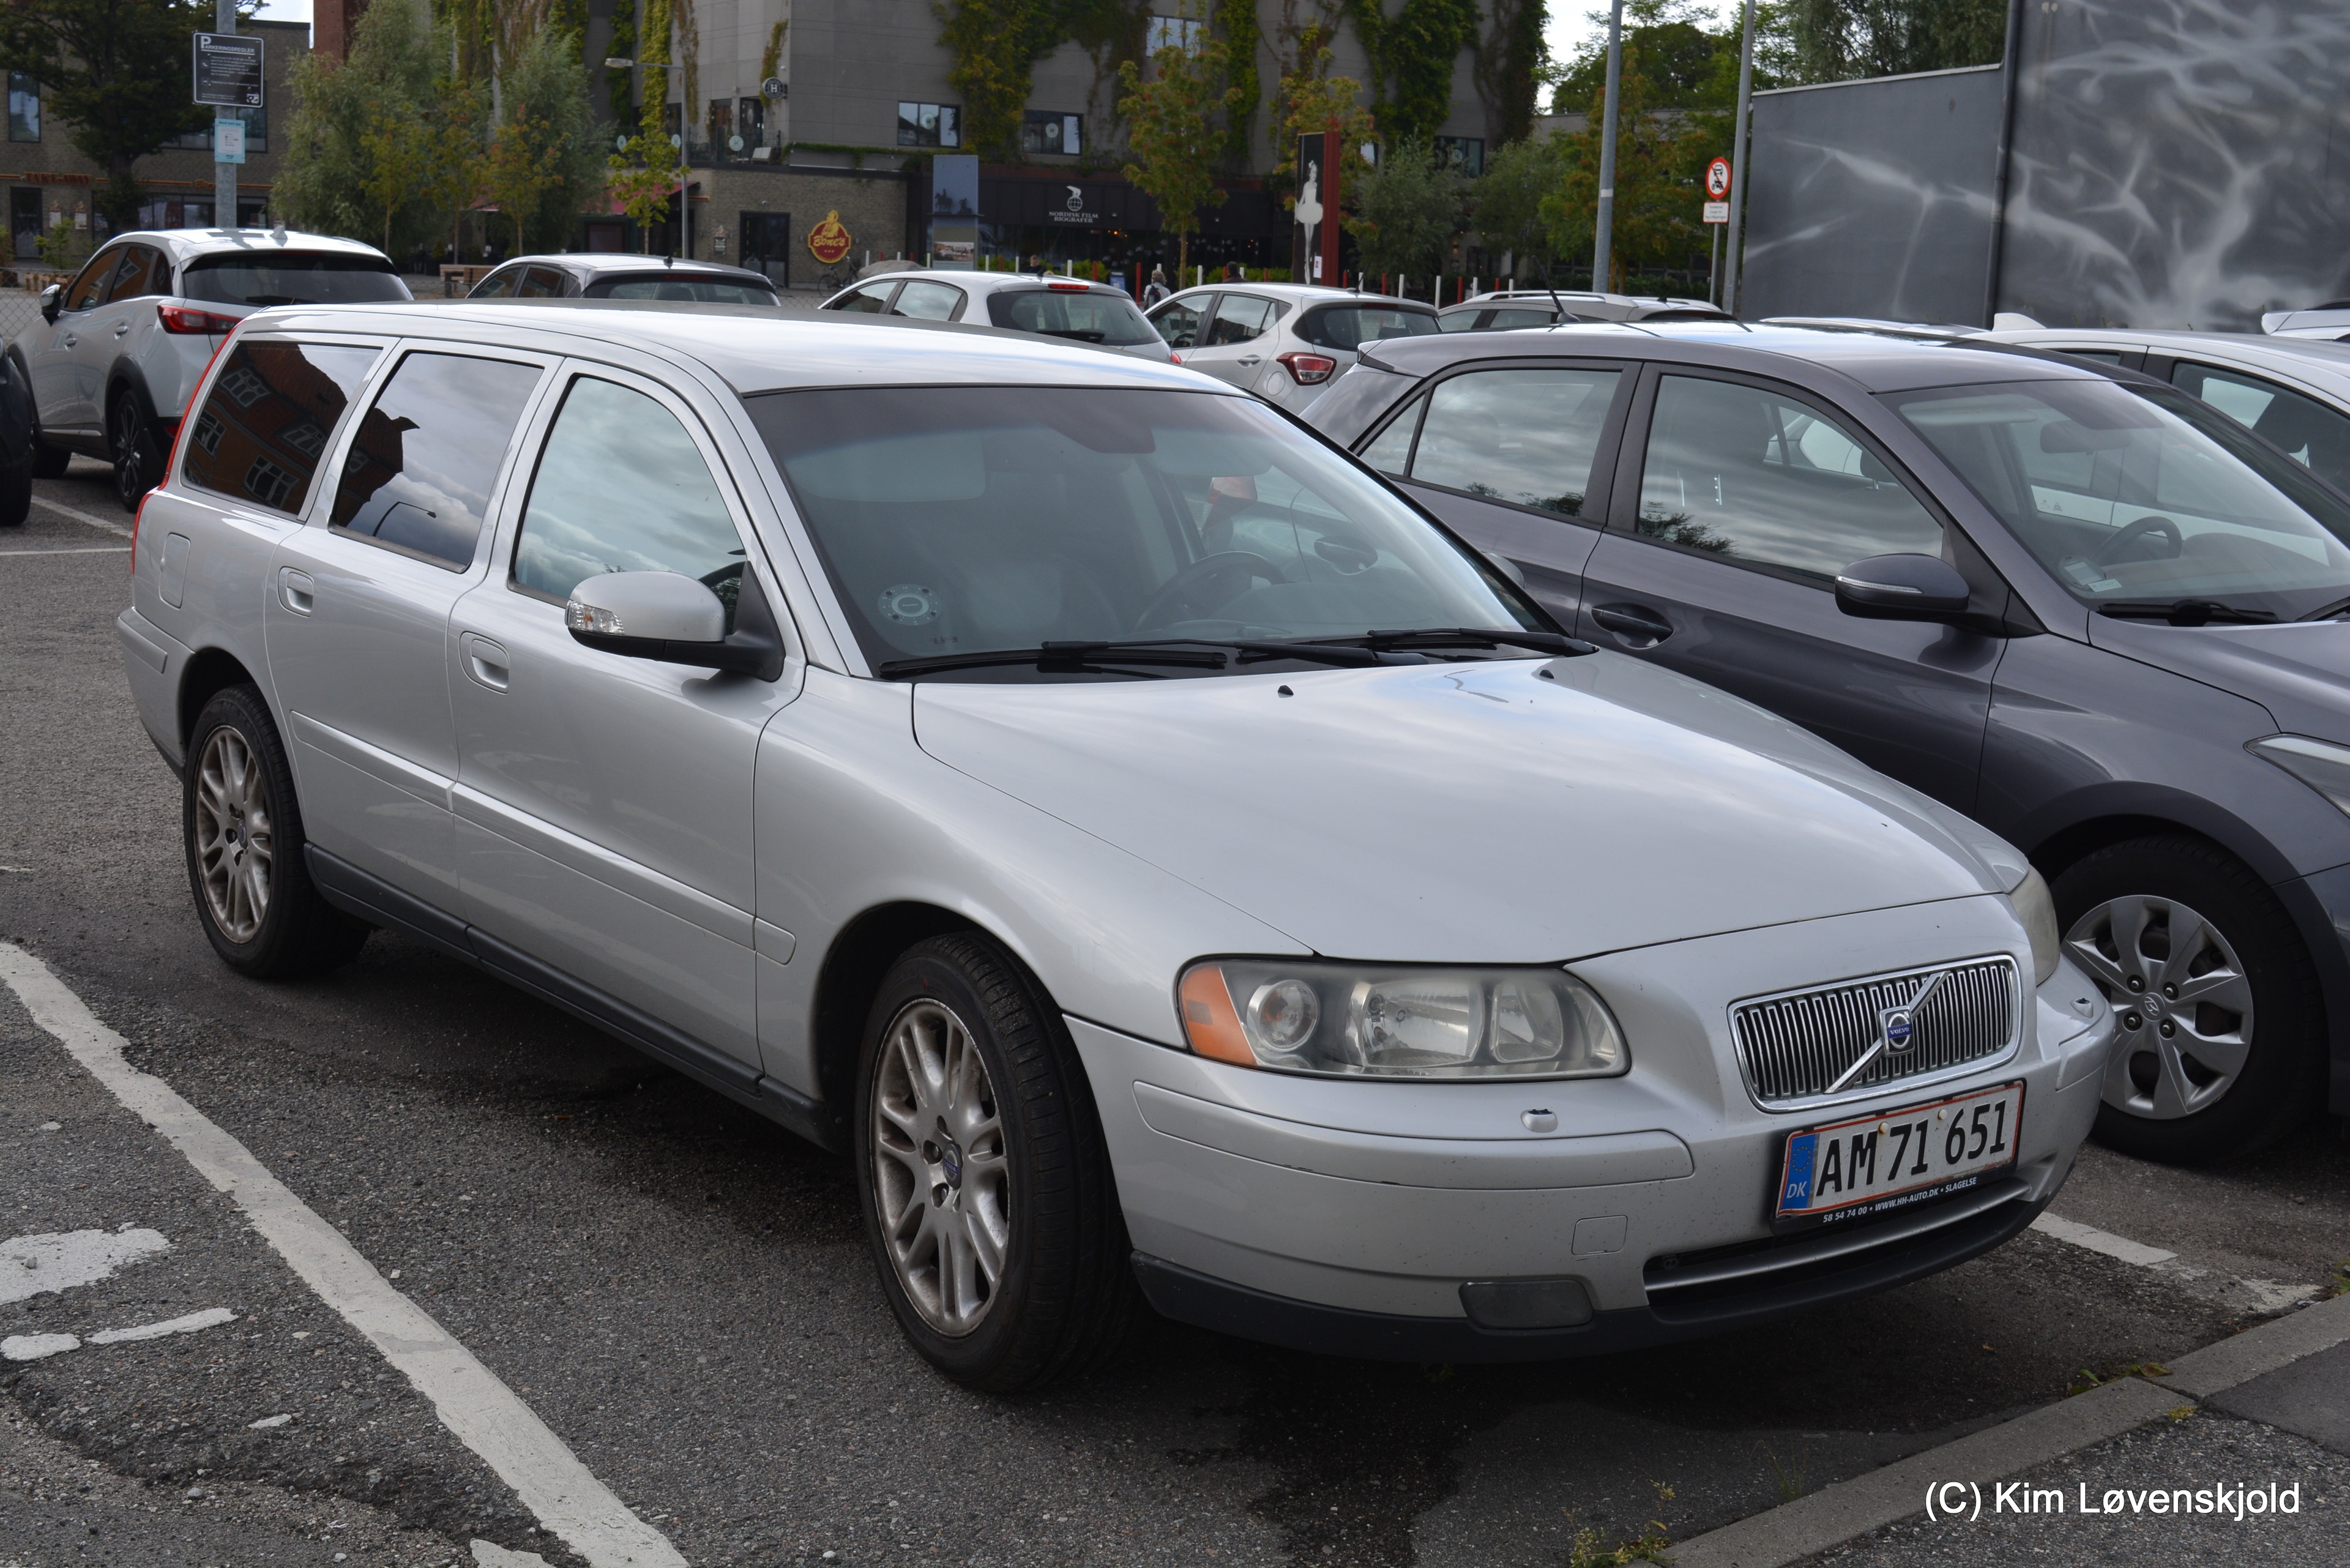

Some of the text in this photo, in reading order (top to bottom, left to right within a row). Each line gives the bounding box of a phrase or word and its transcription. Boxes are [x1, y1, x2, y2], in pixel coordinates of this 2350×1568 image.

[200, 35, 255, 53] PARKERINGSREGLER
[770, 84, 778, 93] H
[24, 171, 92, 184] TAKE-AWAY
[195, 179, 215, 190] Bon
[813, 236, 846, 247] Bone's
[1816, 1100, 2006, 1197] AM 71 651
[1786, 1181, 1807, 1200] DK
[1822, 1177, 1977, 1223] 58 54 74 00 WWW.HH-AUTO.DK SLAGELSE
